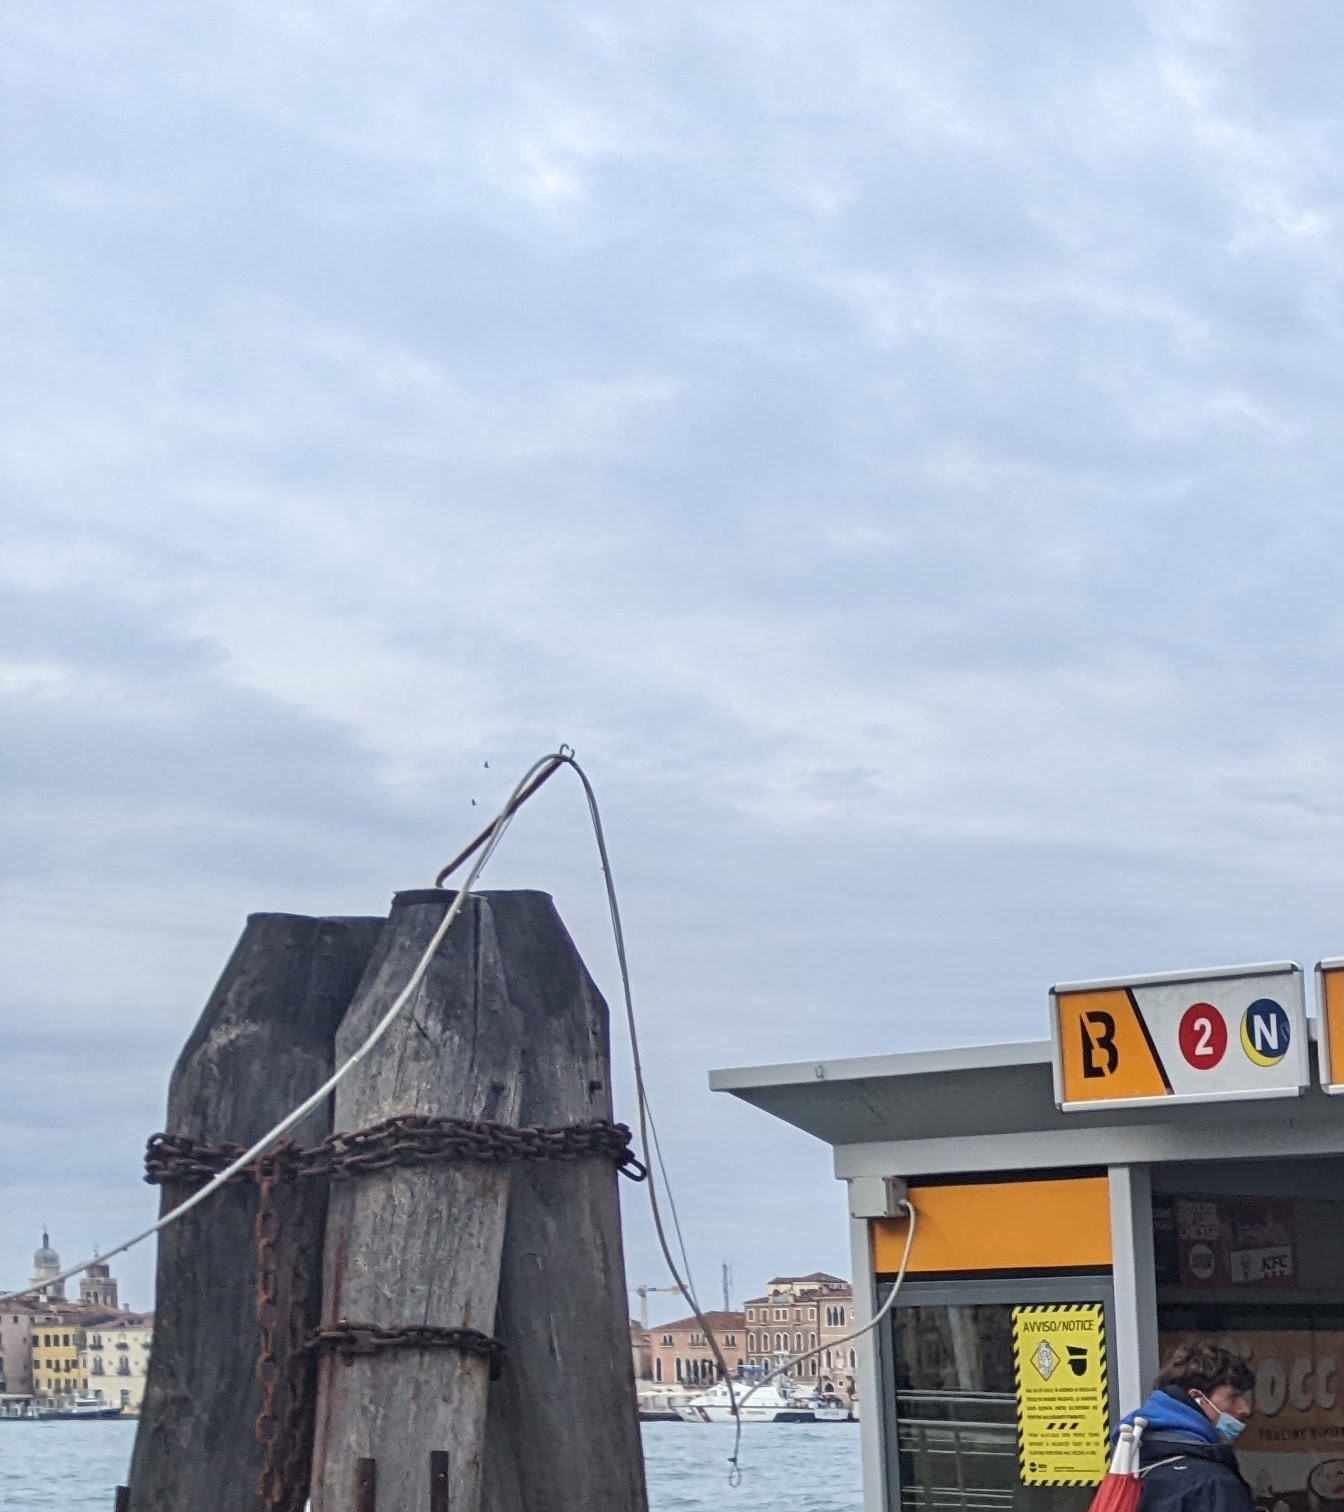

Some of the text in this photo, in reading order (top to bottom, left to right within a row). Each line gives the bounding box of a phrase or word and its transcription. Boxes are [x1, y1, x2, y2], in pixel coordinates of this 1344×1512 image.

[1079, 1010, 1280, 1079] B 2 N
